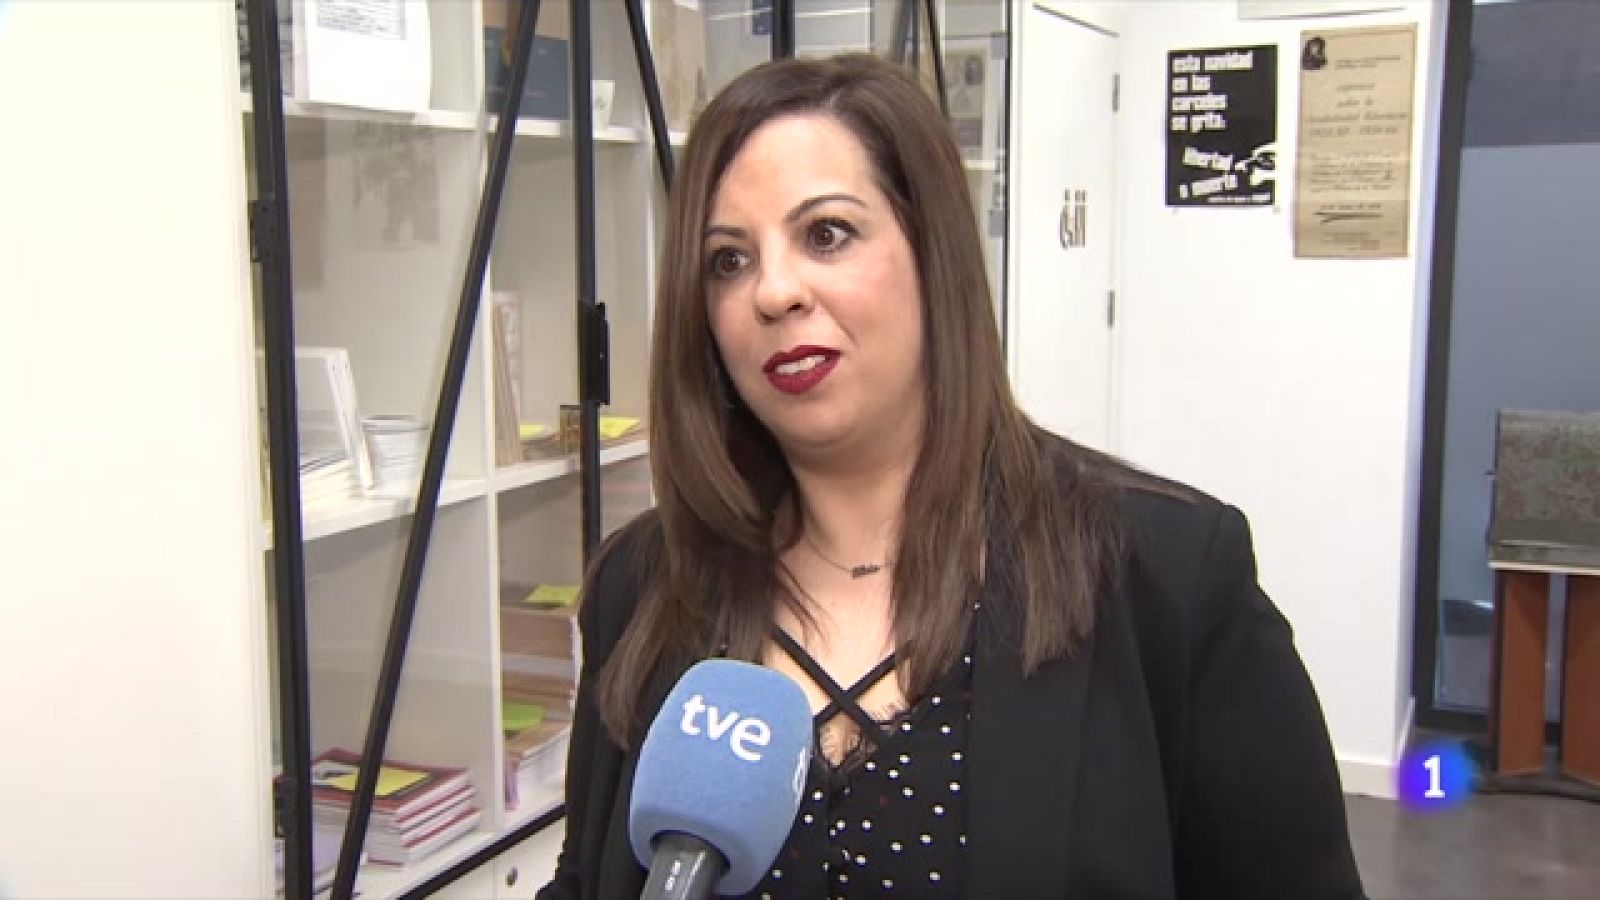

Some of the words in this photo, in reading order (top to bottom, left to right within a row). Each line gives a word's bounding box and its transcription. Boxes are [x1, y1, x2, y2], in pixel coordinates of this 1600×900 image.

[1183, 146, 1234, 171] libertad
[1191, 170, 1239, 196] muerte
[680, 694, 771, 761] tve
